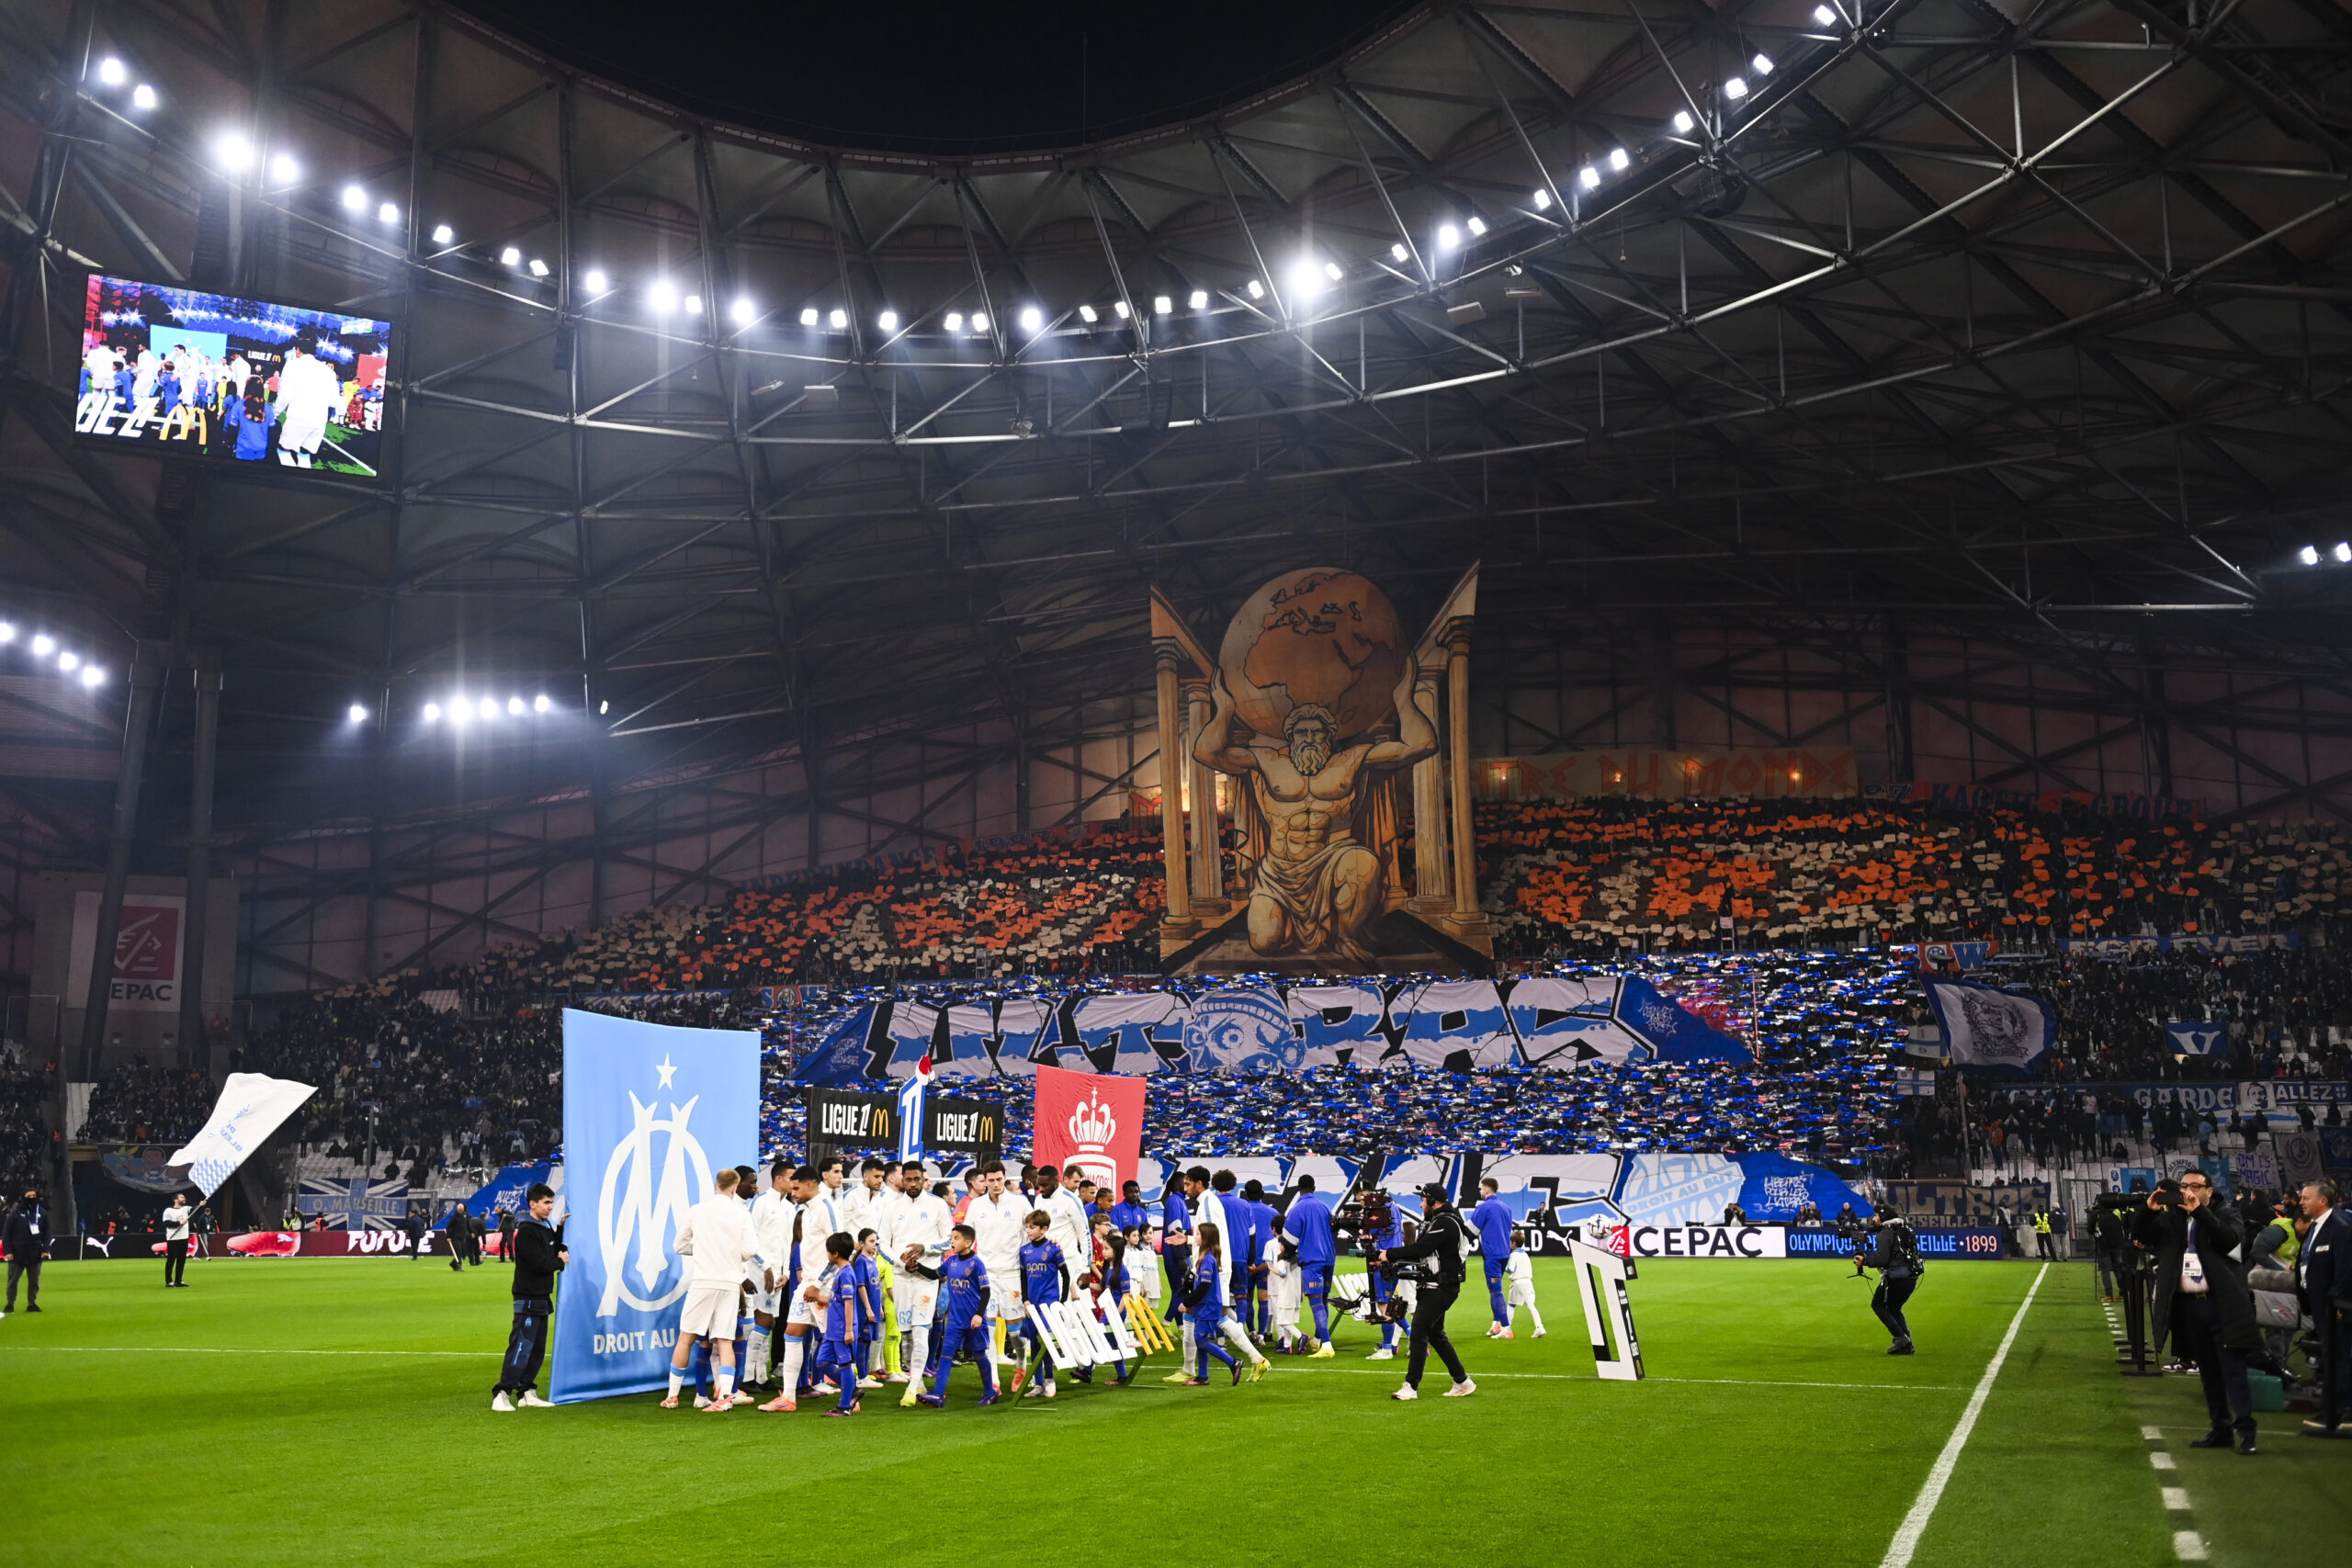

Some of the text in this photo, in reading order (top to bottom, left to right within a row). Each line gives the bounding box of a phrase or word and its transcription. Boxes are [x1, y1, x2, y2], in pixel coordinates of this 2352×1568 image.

[1683, 750, 1854, 797] MONDE
[110, 983, 172, 1001] EPAC
[2277, 1085, 2334, 1100] ALLEZ
[332, 1196, 398, 1215] MARSEILLE
[1626, 1191, 1674, 1213] DROIT
[1678, 1183, 1699, 1199] AU
[347, 1231, 435, 1253] FUTUE
[1634, 1226, 1762, 1257] CEPAC
[1788, 1234, 1858, 1256] OLYMPIQU
[1963, 1235, 1996, 1253] 1899
[950, 1278, 970, 1290] apm
[899, 1310, 912, 1325] 62
[594, 1328, 675, 1355] DROIT AU
